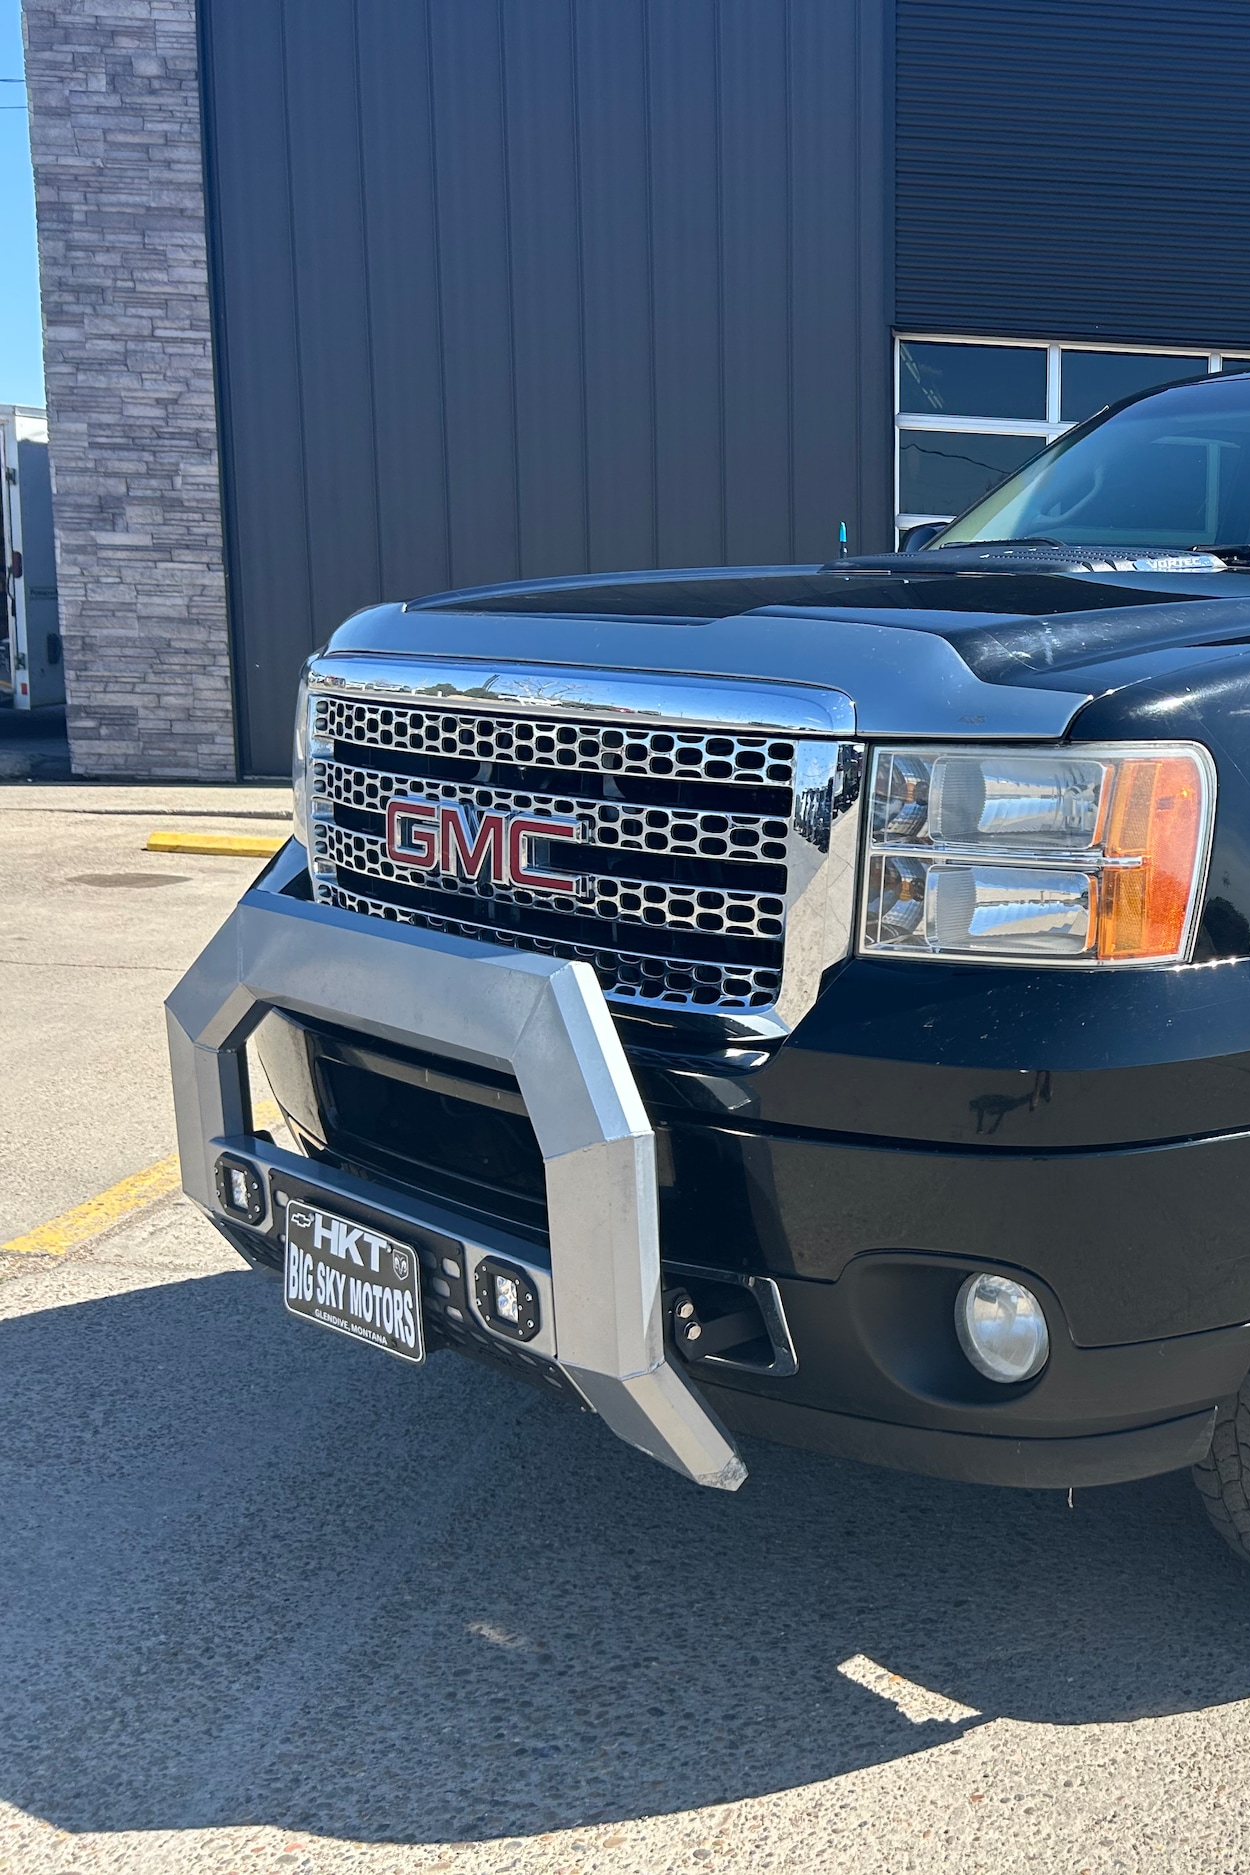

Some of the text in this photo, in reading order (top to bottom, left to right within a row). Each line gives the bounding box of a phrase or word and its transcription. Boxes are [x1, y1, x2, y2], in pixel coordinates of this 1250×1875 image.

[386, 795, 590, 897] GMC
[313, 1212, 388, 1273] HKT
[288, 1241, 415, 1349] BIG SKY MOTORS
[314, 1308, 388, 1346] GLENDIVE, MONTANA
